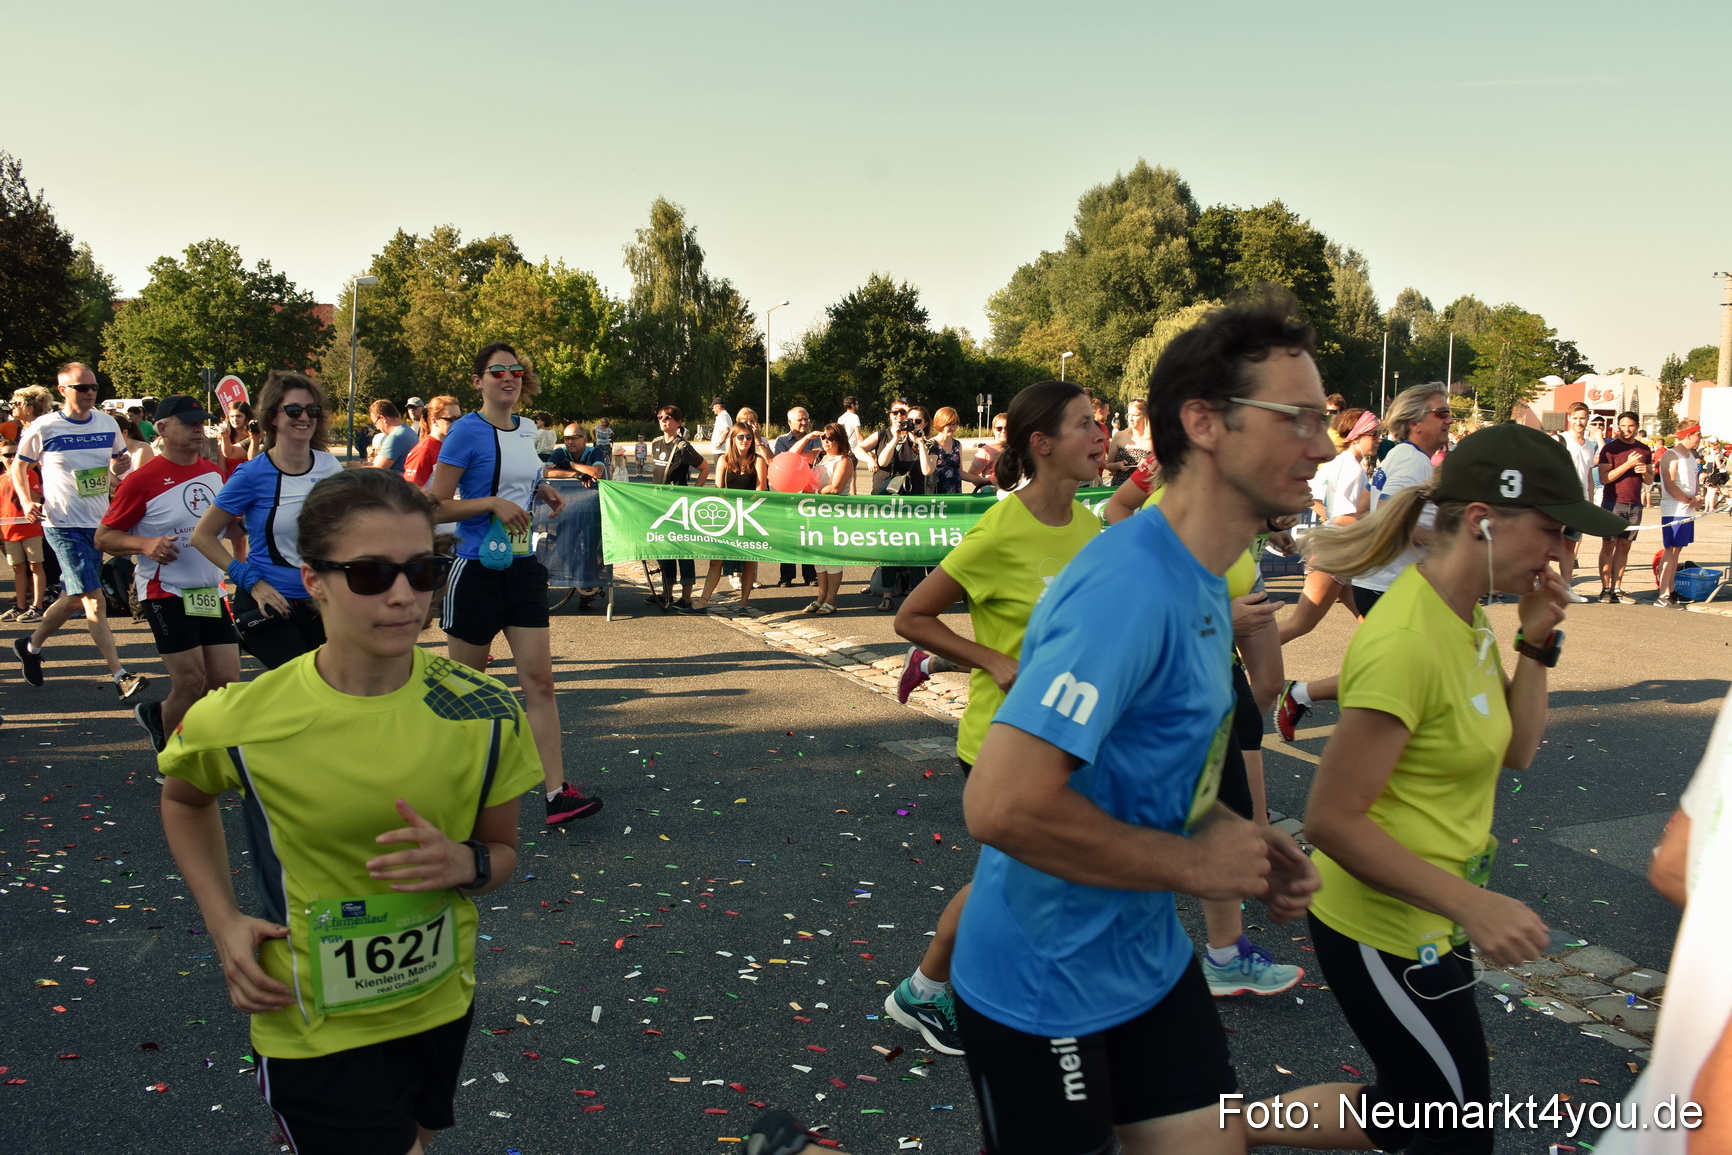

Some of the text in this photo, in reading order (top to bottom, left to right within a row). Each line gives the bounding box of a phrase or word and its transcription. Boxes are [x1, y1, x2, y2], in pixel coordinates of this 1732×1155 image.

[76, 434, 108, 443] PLAST
[81, 475, 107, 489] 1949
[1499, 469, 1523, 499] 3
[649, 495, 770, 537] AOK
[797, 497, 948, 519] Gesundheit
[646, 532, 665, 543] Die
[799, 525, 967, 547] in besten Hä
[188, 593, 217, 608] 1565
[1040, 671, 1099, 726] m
[334, 914, 446, 979] 1627
[354, 960, 438, 990] Kienlein Maria
[376, 976, 420, 995] real GmbH
